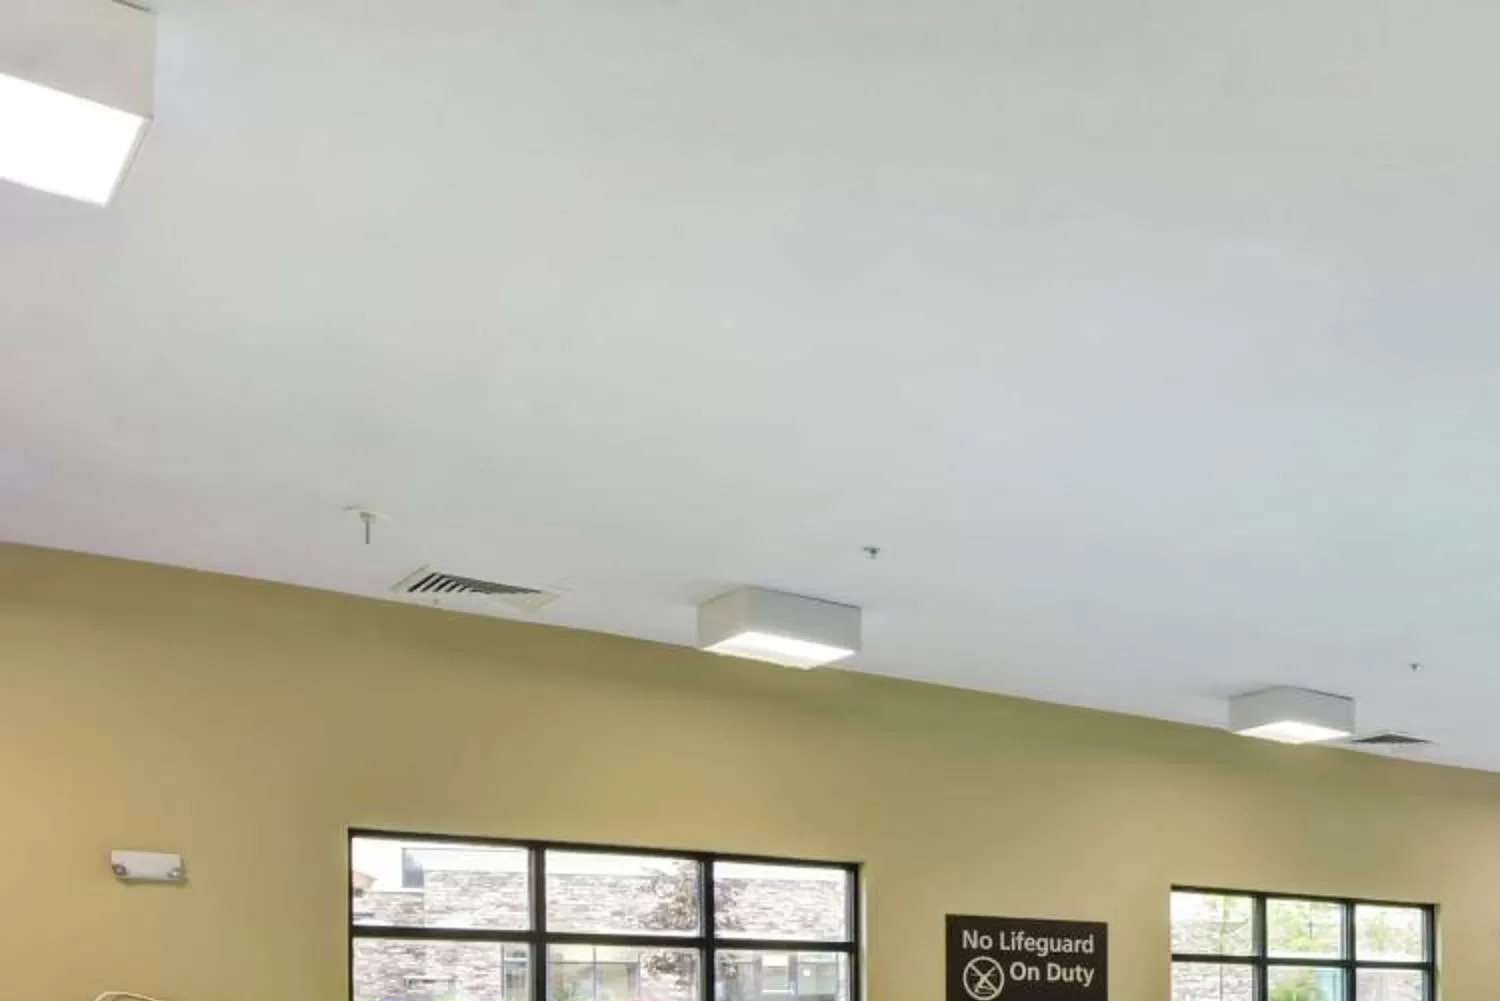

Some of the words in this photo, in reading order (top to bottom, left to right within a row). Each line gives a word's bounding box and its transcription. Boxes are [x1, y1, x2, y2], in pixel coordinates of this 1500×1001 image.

[962, 929, 993, 950] No
[1000, 931, 1095, 957] Lifeguard
[1009, 961, 1040, 981] On
[1047, 963, 1096, 987] Duty
